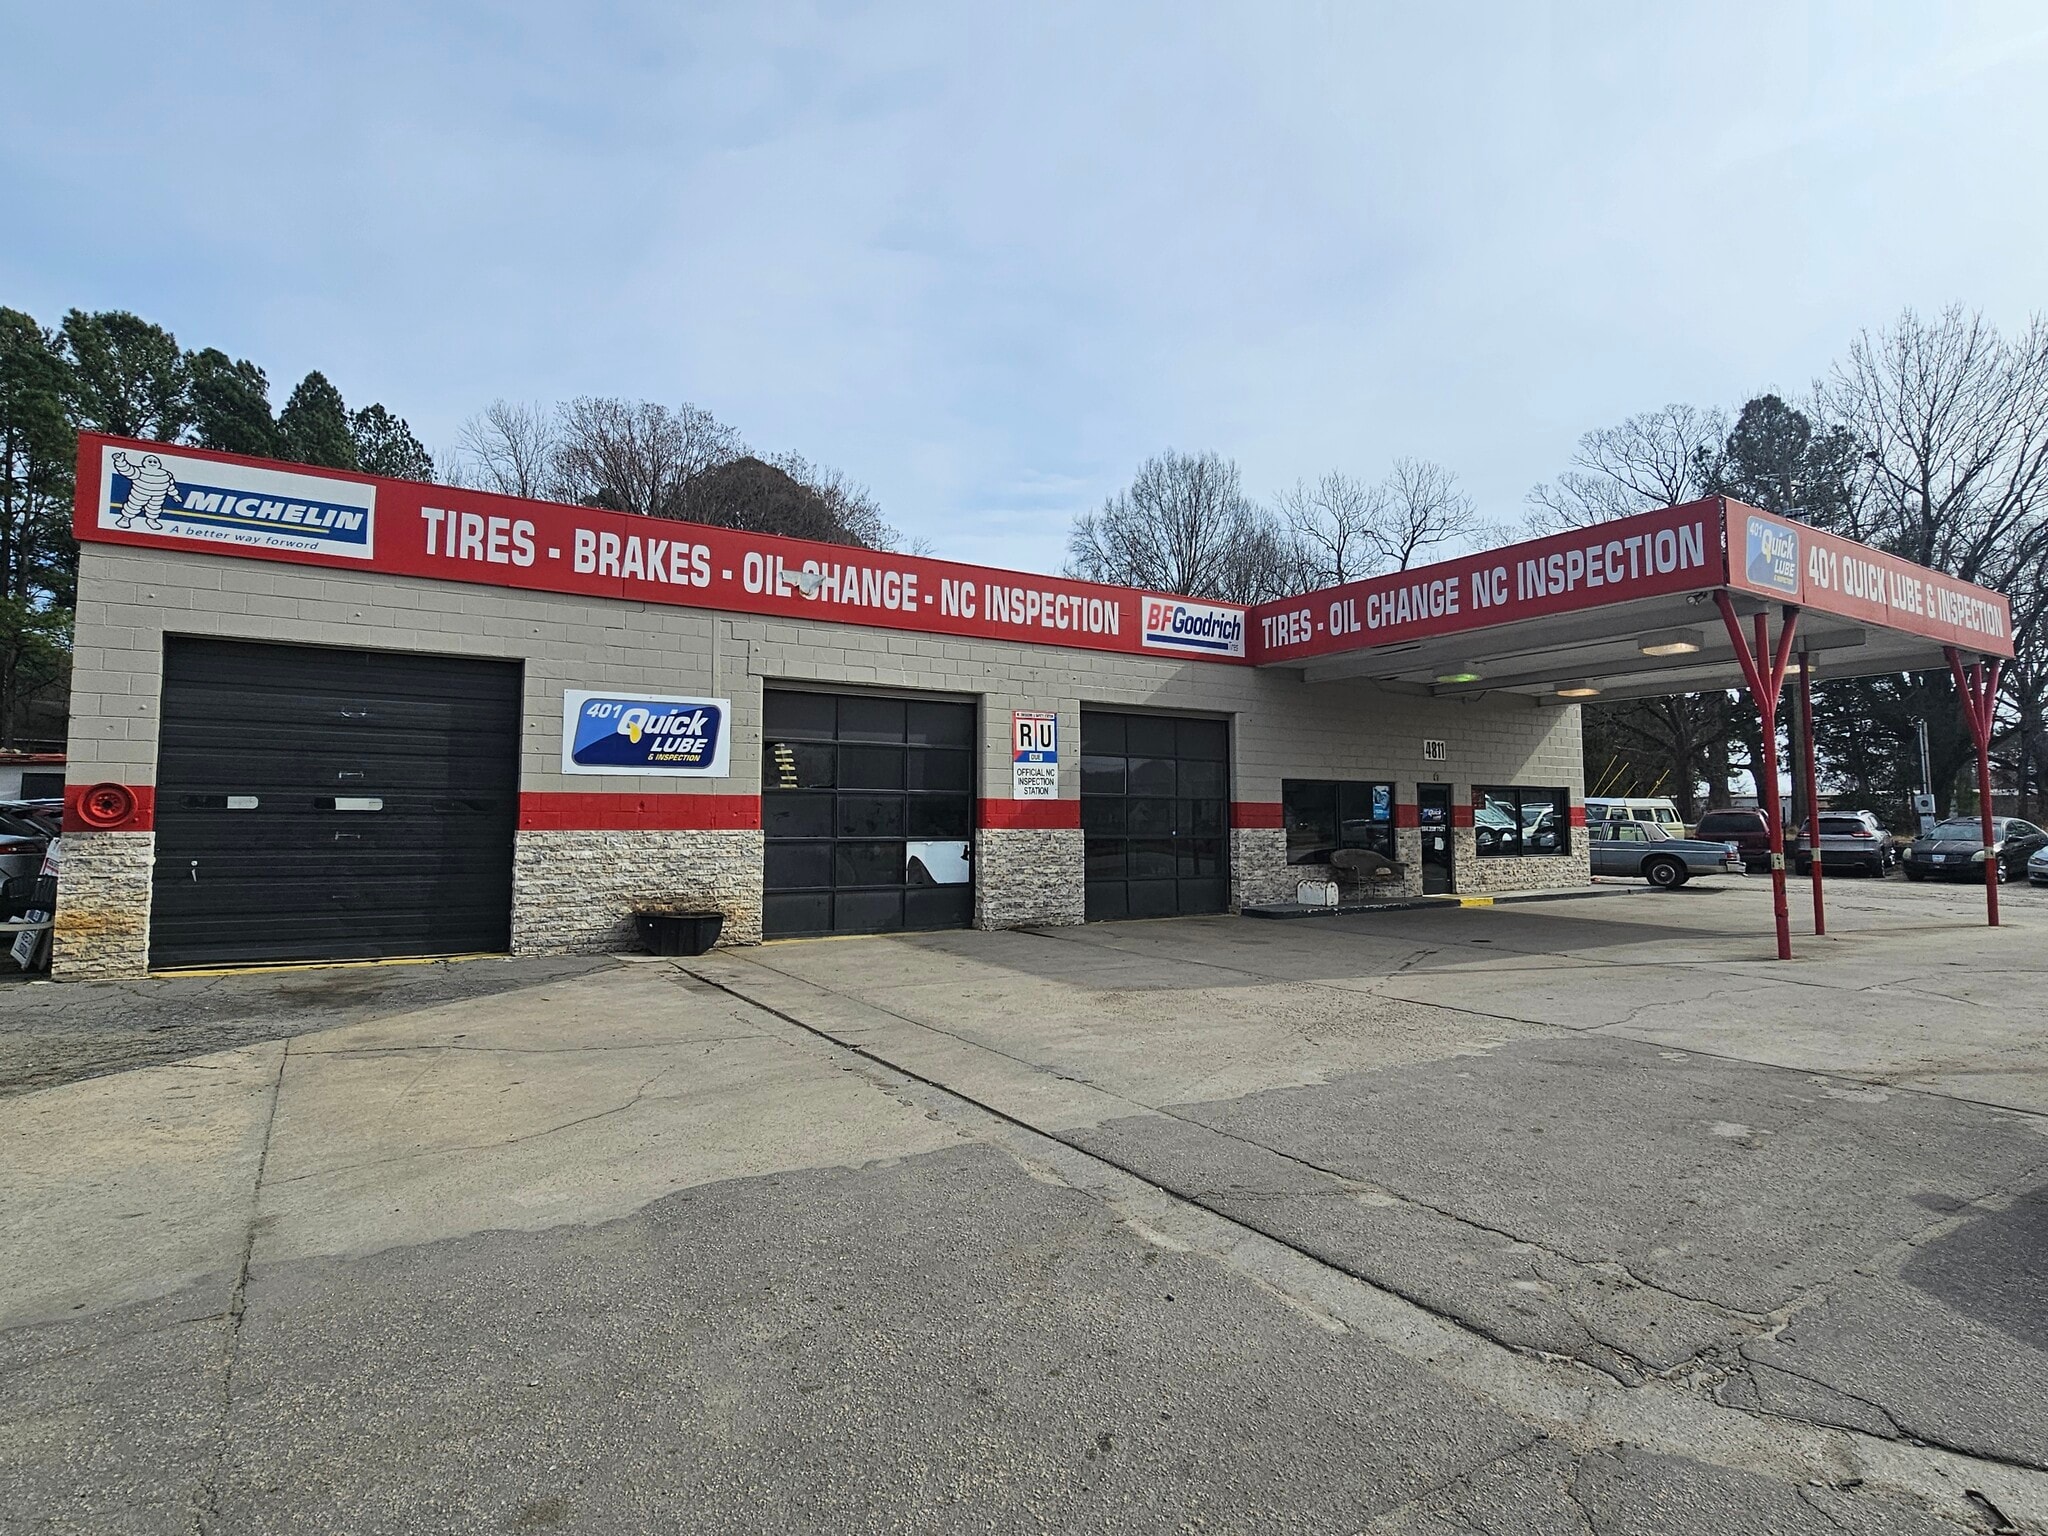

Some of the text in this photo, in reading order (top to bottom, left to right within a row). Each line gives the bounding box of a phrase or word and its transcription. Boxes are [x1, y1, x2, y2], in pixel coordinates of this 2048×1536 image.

[183, 490, 364, 531] MICHELIN
[169, 525, 179, 533] A
[186, 526, 229, 540] better
[235, 534, 260, 545] way
[1750, 522, 1763, 537] 401
[1761, 528, 1794, 562] Quick
[421, 506, 535, 567] TIRES
[574, 528, 710, 588] BRAKES
[743, 552, 791, 597] OIL
[941, 579, 975, 618] NC
[985, 584, 1119, 635] INSPECTION
[1774, 559, 1795, 577] LUBE
[1262, 608, 1312, 648] TIRES
[1330, 599, 1360, 636] OIL
[1367, 577, 1459, 630] CHANGE
[1472, 566, 1507, 610] NC
[1518, 522, 1704, 600] INSPECTION
[1809, 545, 2004, 638] 401 QUICK LUBE & INSPECTION
[587, 703, 623, 718] 401
[617, 708, 708, 743] Quick
[650, 737, 708, 753] LUBE
[1426, 741, 1445, 759] 4811
[655, 753, 701, 762] INSPECTION
[1017, 768, 1055, 777] OFFICIAL NC
[1018, 777, 1054, 786] INSPECTION
[1024, 787, 1049, 795] STATION
